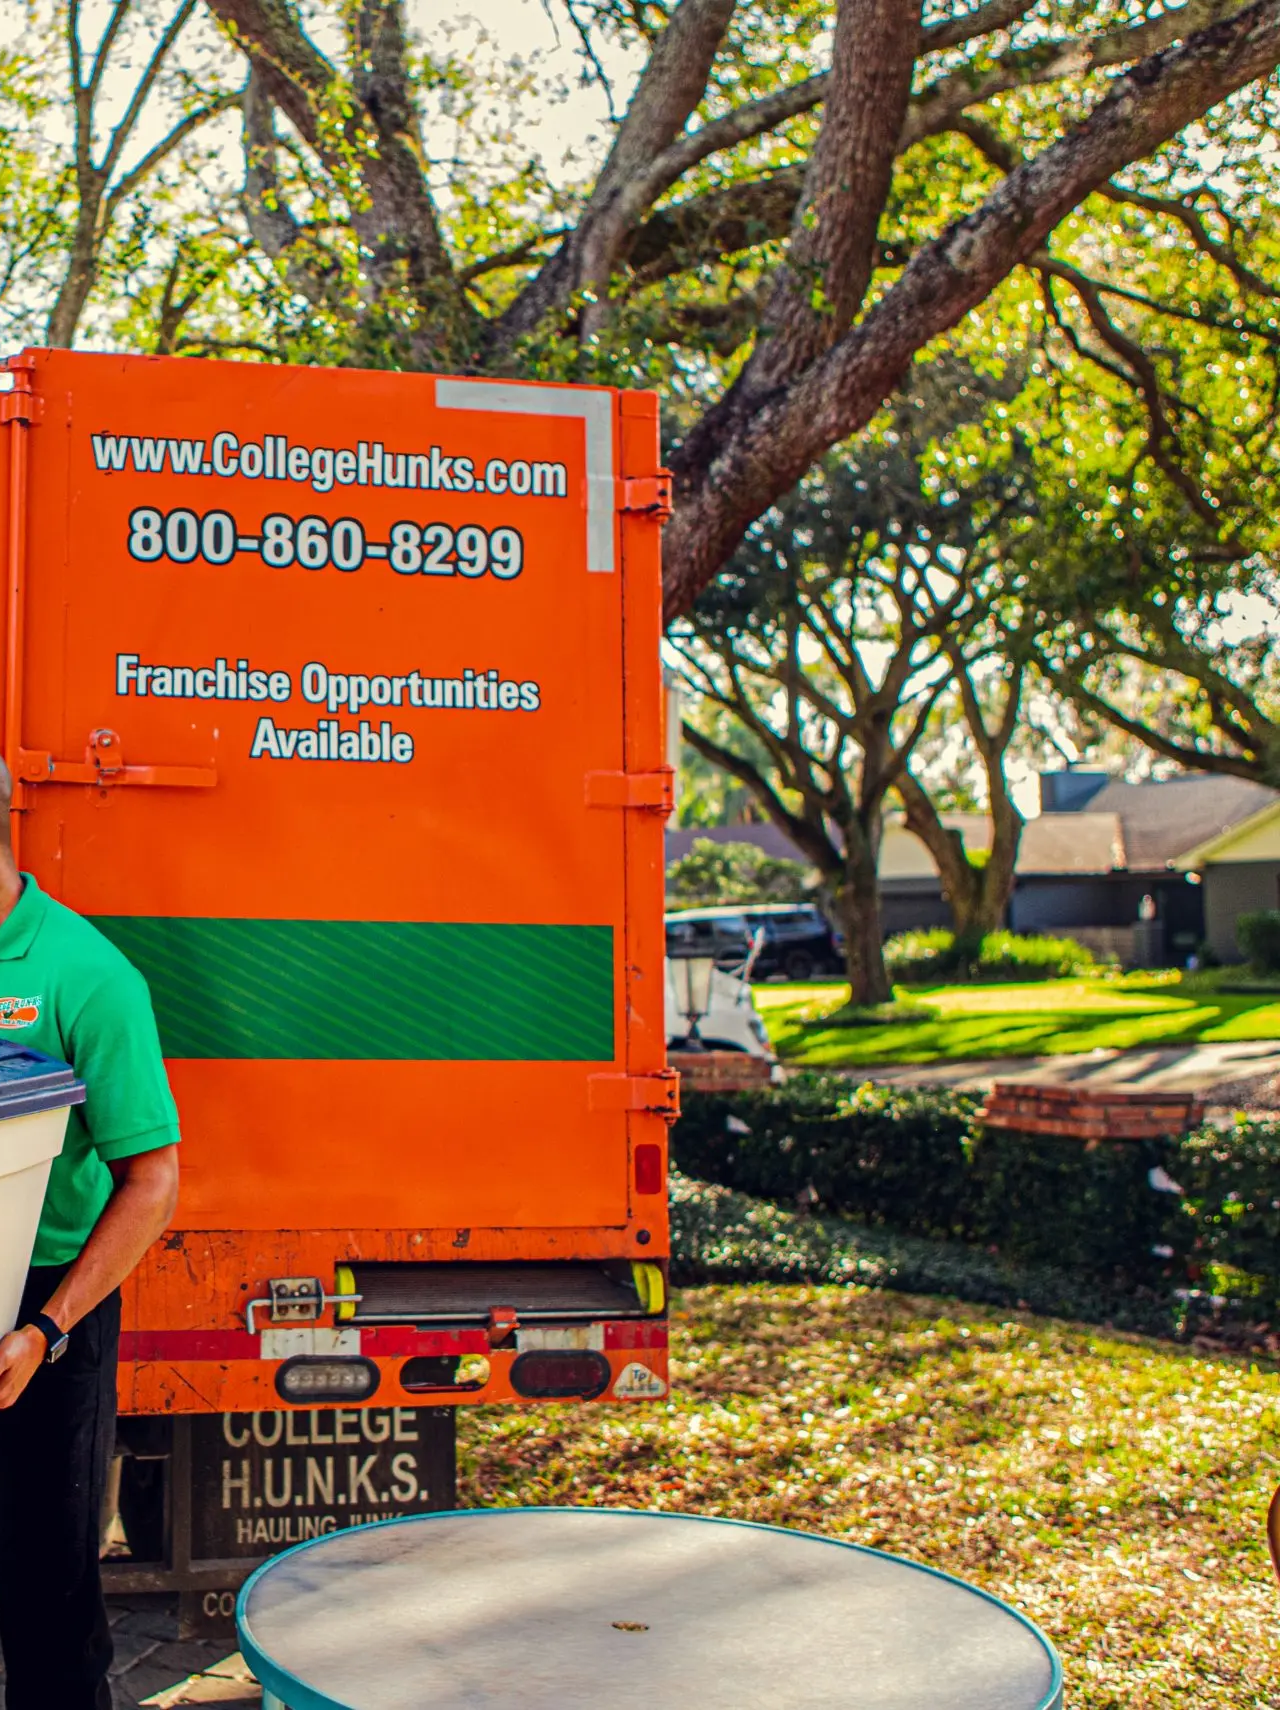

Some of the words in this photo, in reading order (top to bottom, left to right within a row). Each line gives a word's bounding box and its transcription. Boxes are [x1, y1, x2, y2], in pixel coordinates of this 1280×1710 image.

[91, 432, 568, 497] www.CollegeHunks.com
[128, 507, 524, 580] 800-860-8299
[116, 654, 291, 702] Franchise
[300, 661, 541, 714] Opportunities
[249, 717, 415, 763] Available
[223, 1406, 419, 1447] COLLEGE
[222, 1453, 428, 1509] H.U.N.K.S.
[236, 1515, 338, 1544] HAULING
